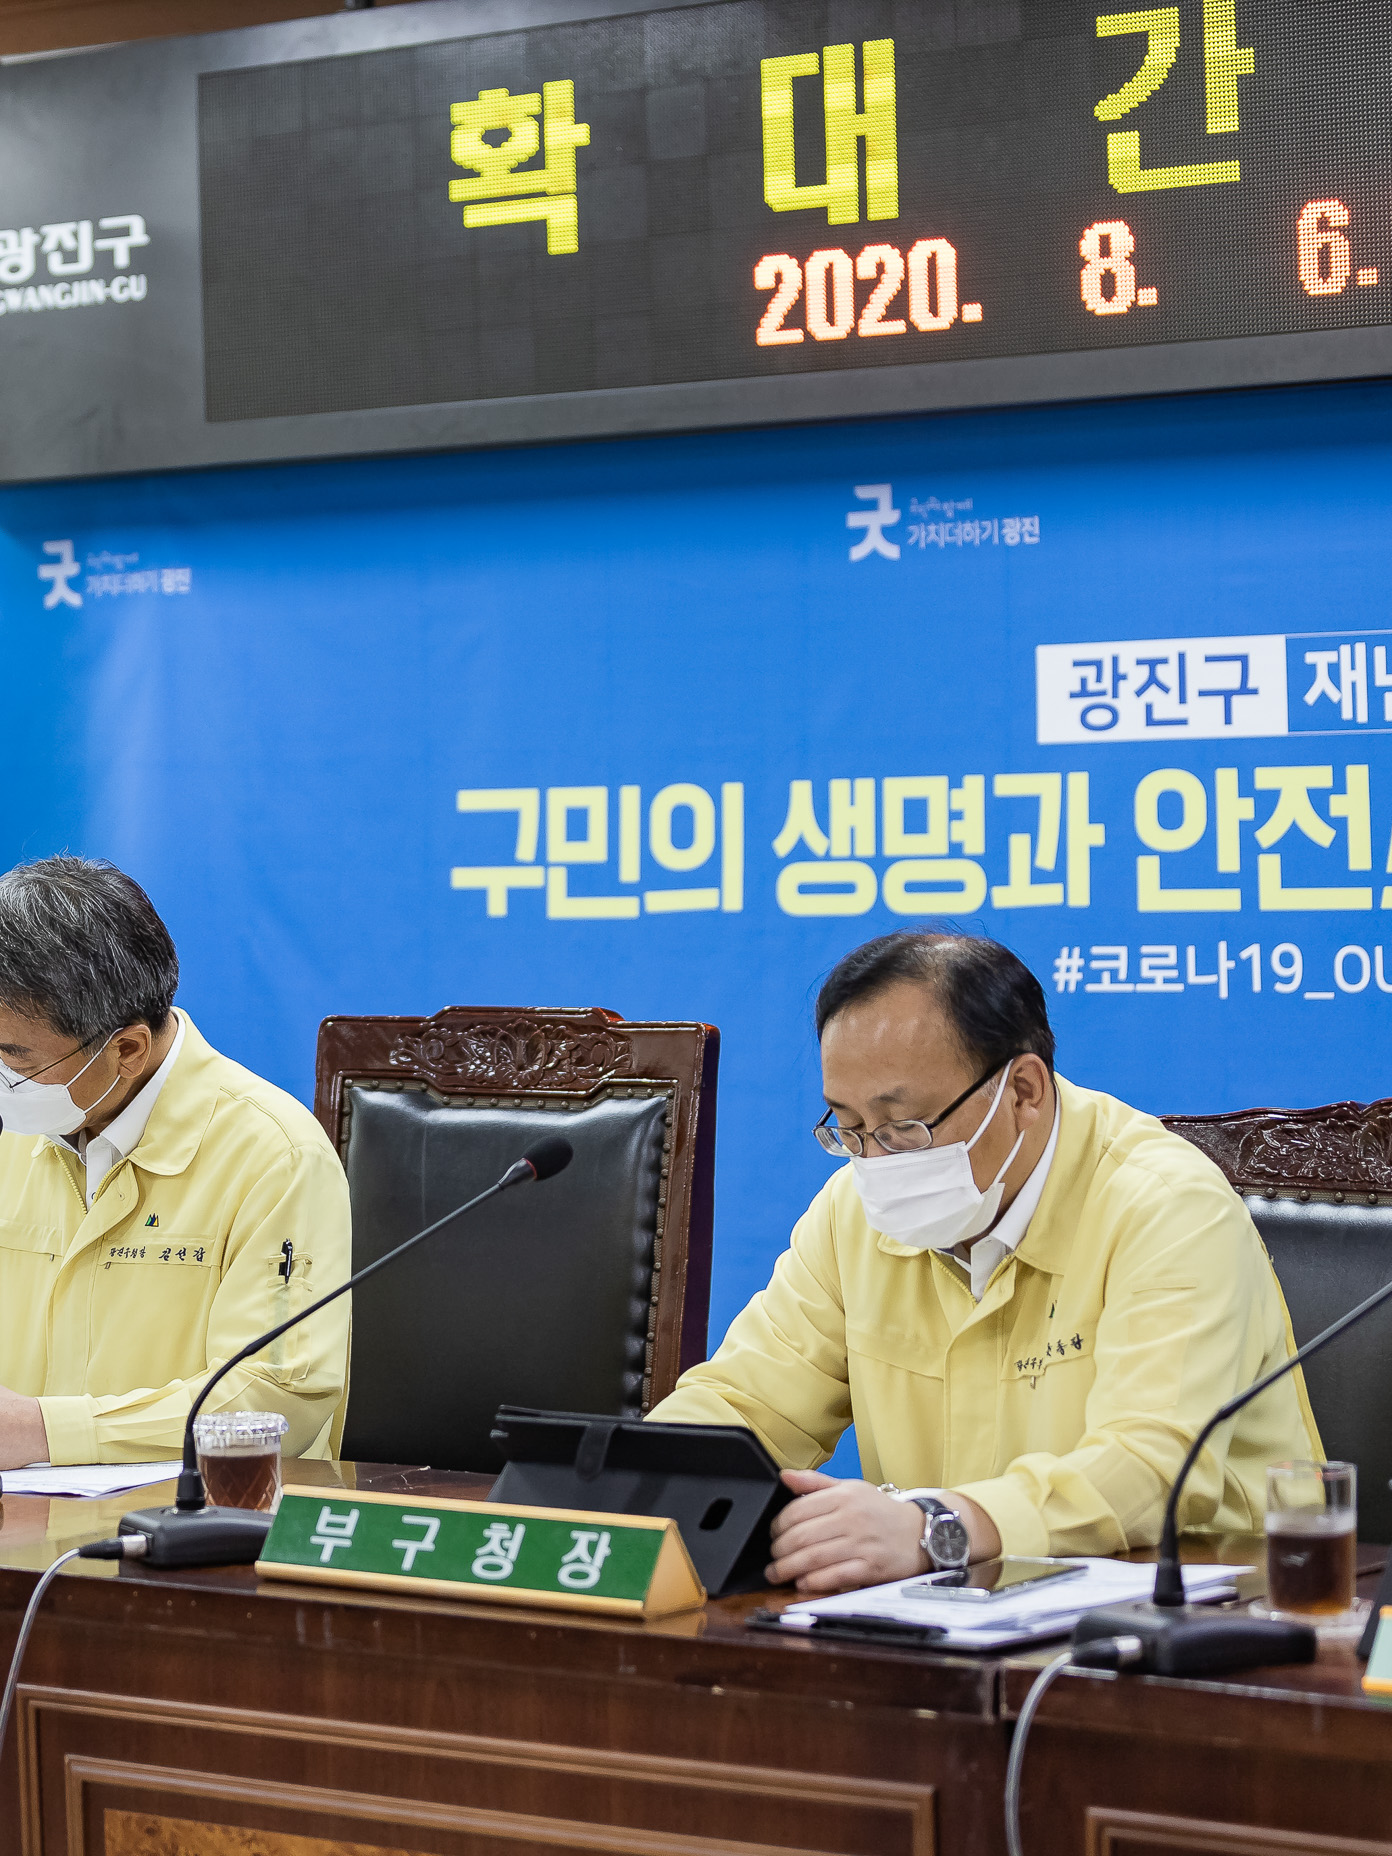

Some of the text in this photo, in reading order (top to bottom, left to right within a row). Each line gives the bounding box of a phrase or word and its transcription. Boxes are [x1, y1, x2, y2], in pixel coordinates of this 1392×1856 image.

[449, 79, 591, 255] 확
[761, 38, 899, 225] 대
[754, 198, 1378, 346] 2020. 8. 6.
[847, 484, 901, 562] 굿
[1001, 515, 1040, 546] 광진
[38, 540, 83, 609] 굿
[1070, 652, 1259, 731] 광진구
[450, 764, 1392, 920] 구민의 생명과 안전
